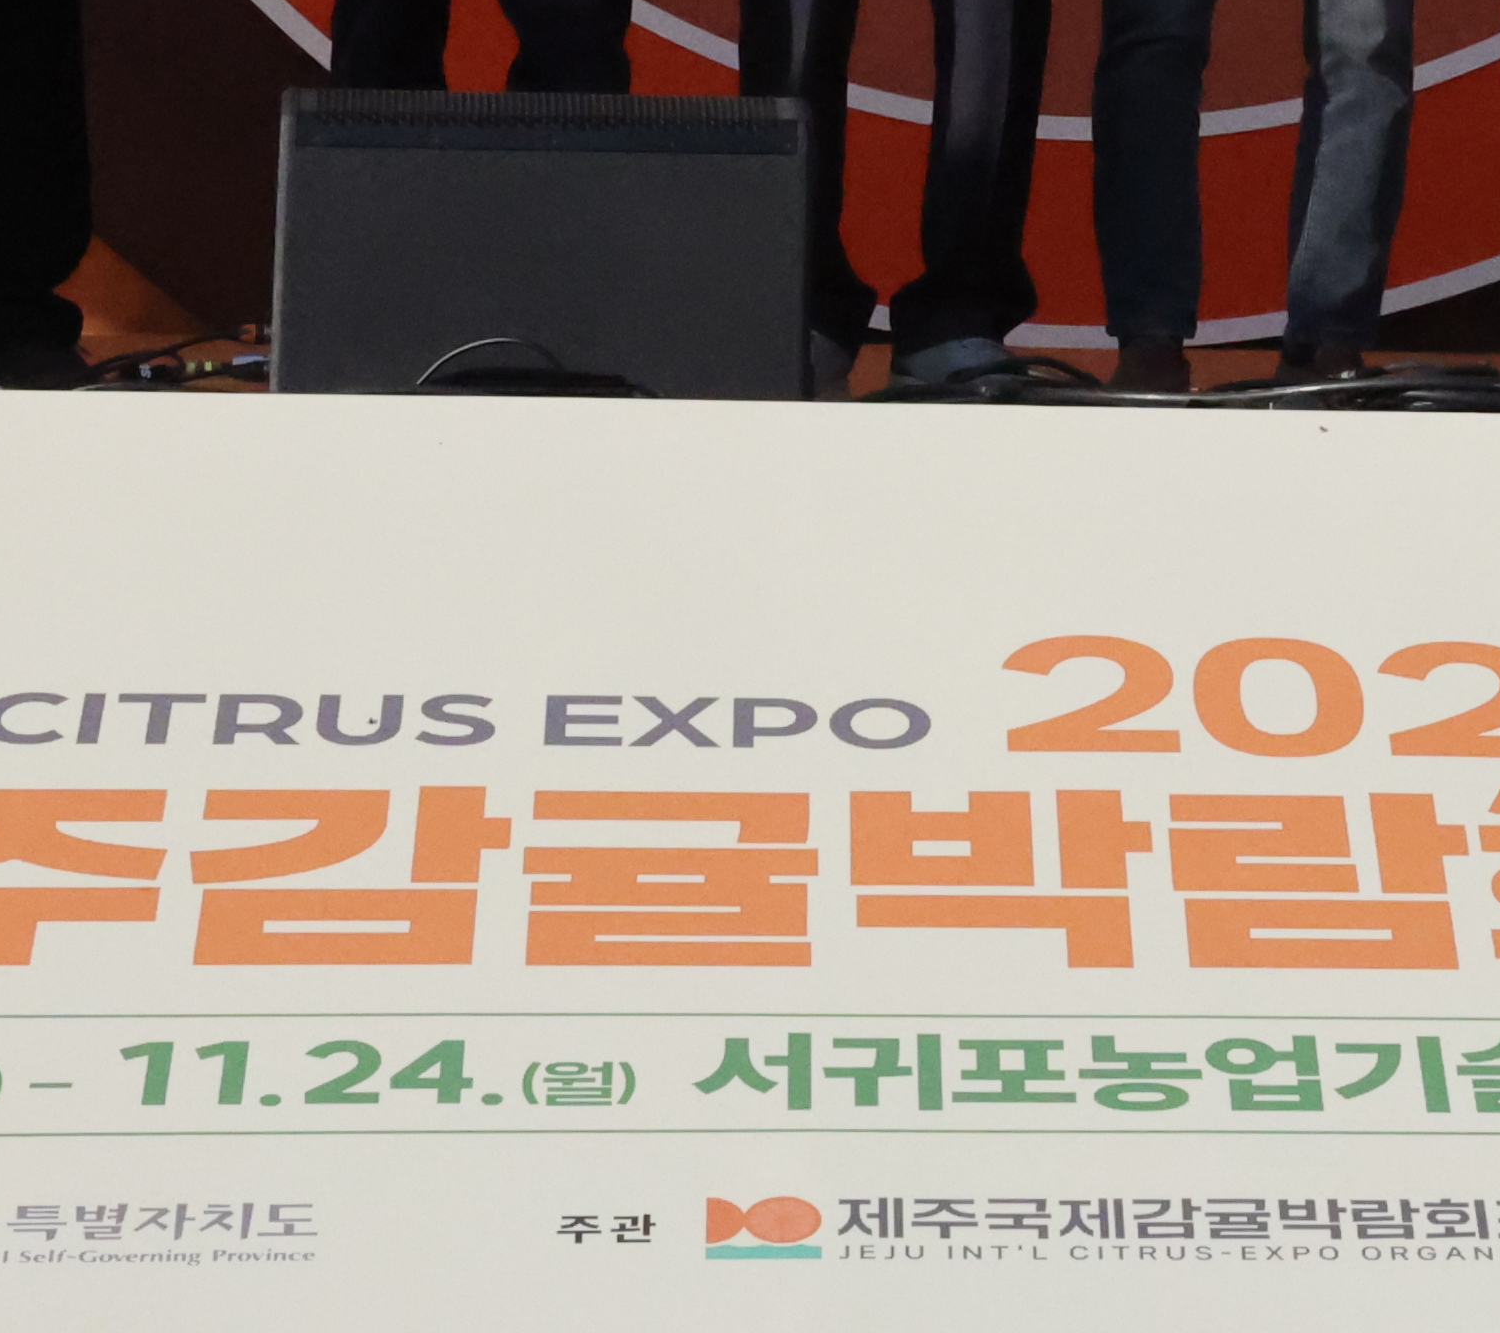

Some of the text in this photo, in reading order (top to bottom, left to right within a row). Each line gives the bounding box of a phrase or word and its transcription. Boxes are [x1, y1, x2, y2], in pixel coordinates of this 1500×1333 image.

[542, 694, 932, 751] EXPO
[19, 1248, 201, 1267] Self-Governing
[212, 1248, 316, 1264] Province
[839, 1244, 926, 1260] JEJU
[948, 1244, 1048, 1260] INT'L
[1069, 1244, 1341, 1261] CITRUS-EXPO
